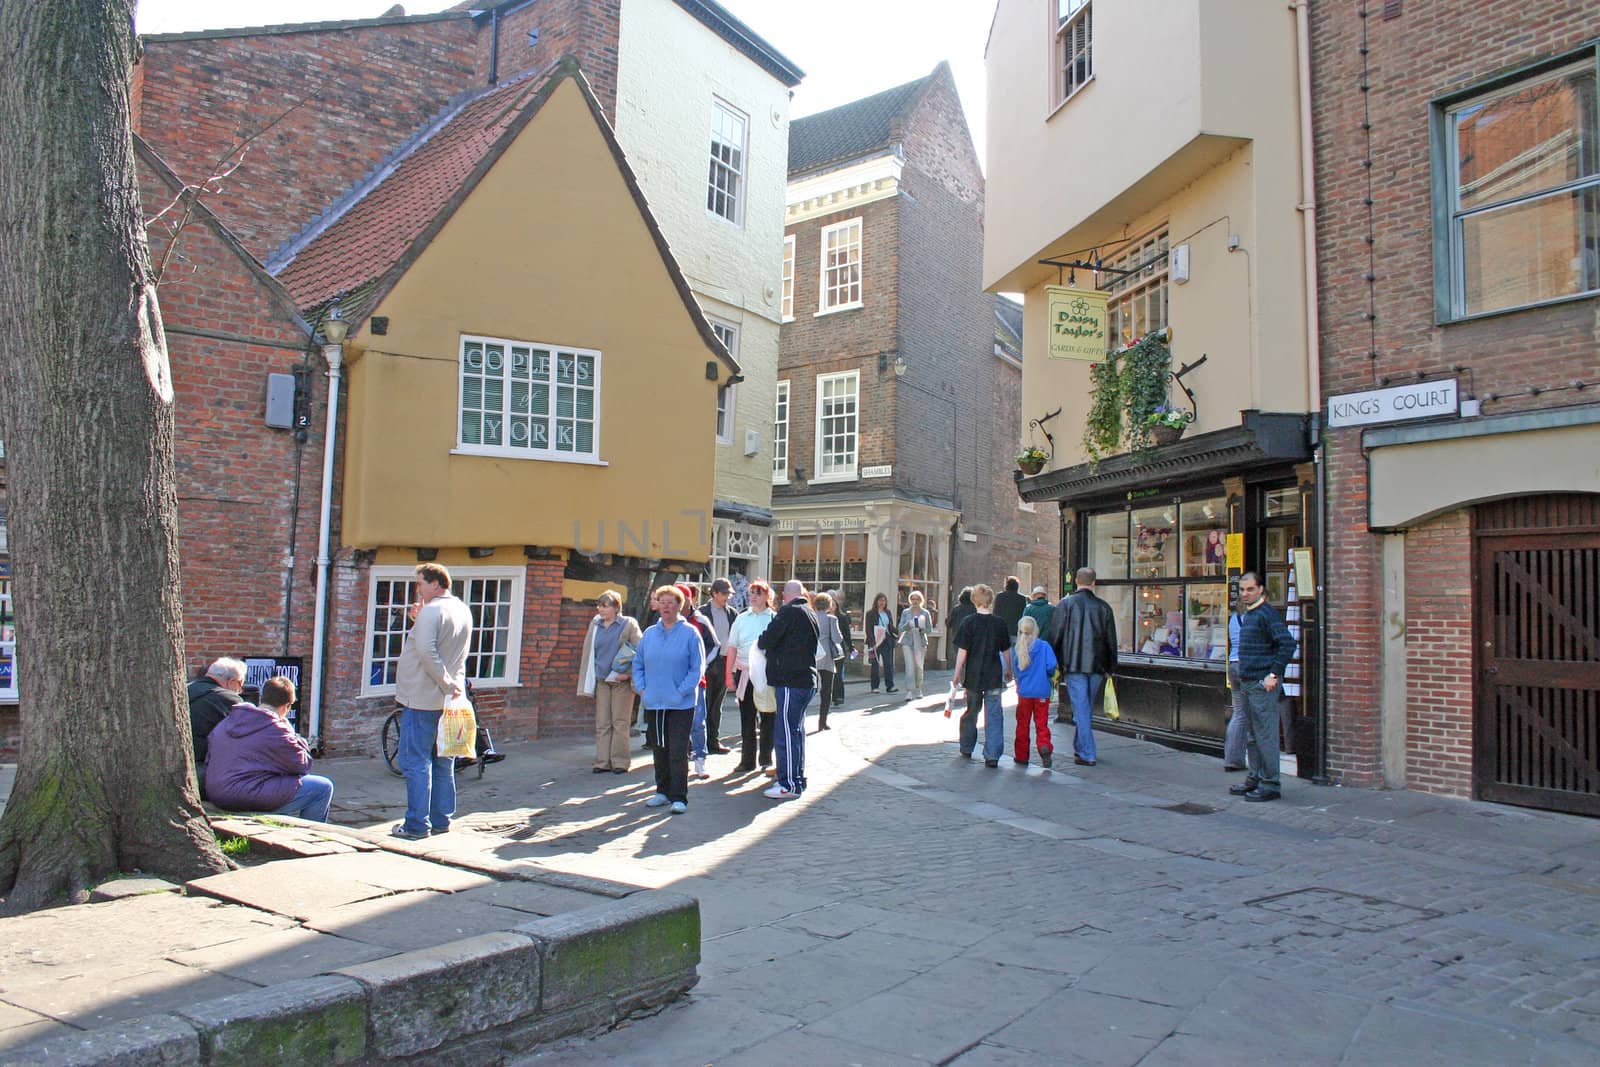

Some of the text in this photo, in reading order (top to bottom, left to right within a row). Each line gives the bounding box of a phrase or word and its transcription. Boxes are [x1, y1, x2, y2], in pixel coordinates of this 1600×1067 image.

[1058, 311, 1098, 328] Daisy
[1054, 323, 1104, 339] Taylor's
[466, 348, 589, 380] COPLEYS
[1333, 388, 1451, 419] KING'S COURT
[299, 415, 307, 425] 2
[485, 419, 573, 444] YORK
[276, 665, 299, 687] TOUR
